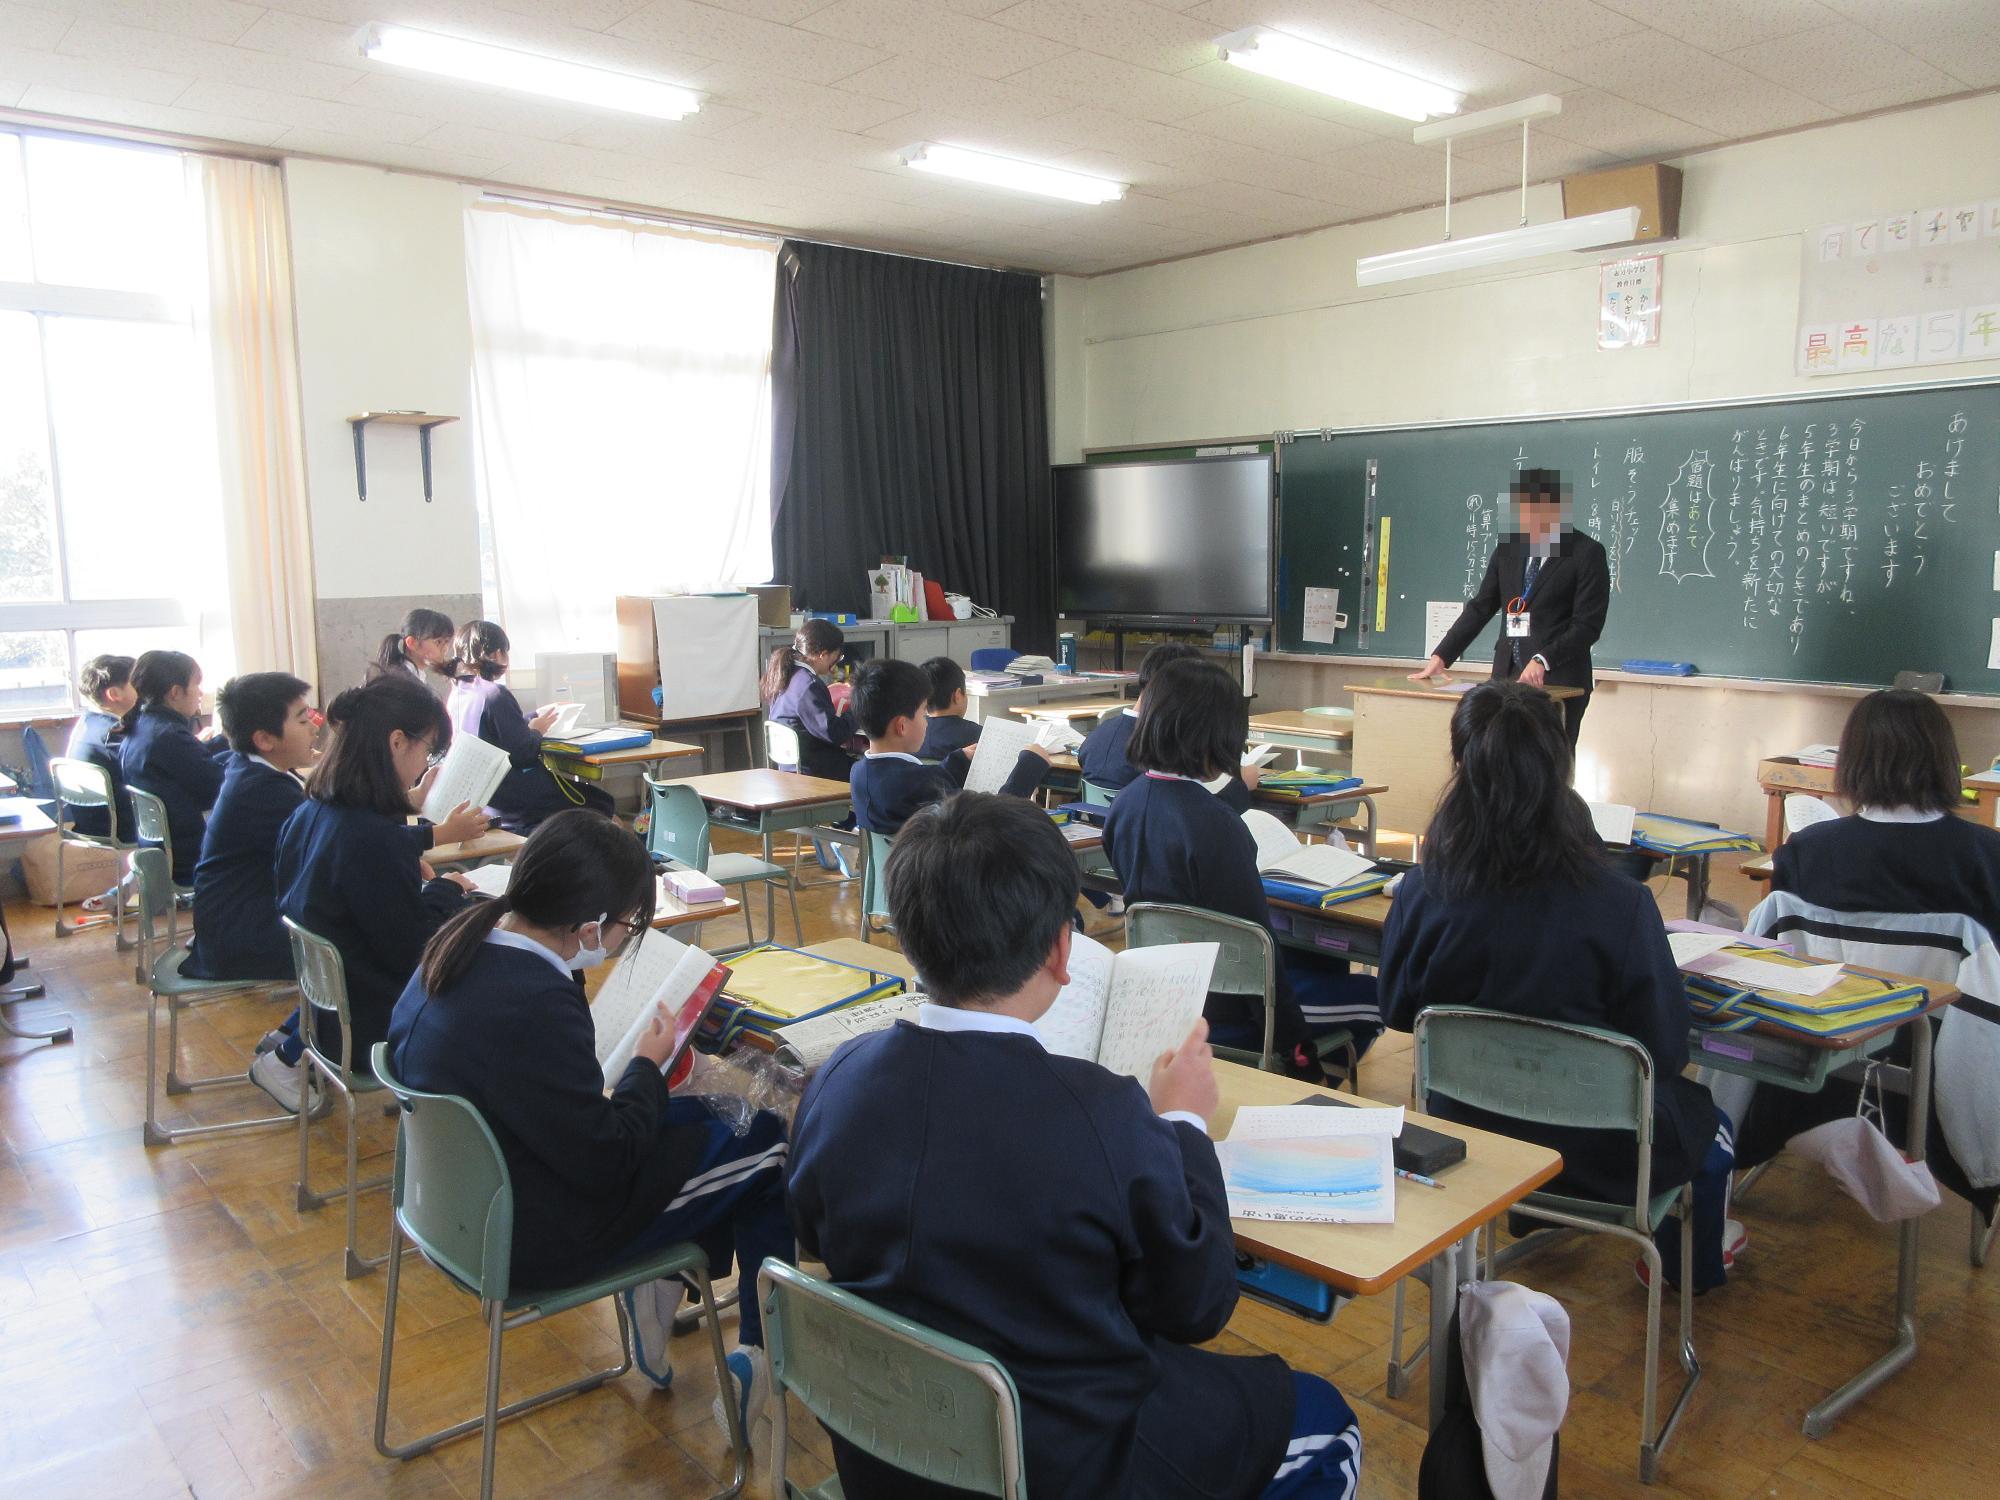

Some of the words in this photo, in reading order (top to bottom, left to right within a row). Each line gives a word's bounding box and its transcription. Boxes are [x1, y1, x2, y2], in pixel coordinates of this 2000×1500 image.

[1687, 458, 1706, 548] 宿題はあとで
[1766, 425, 1790, 616] 6年生に向けての大切な
[1912, 461, 1934, 576] おめでとう
[1940, 412, 1968, 523] あけまして
[1881, 484, 1907, 588] ございます
